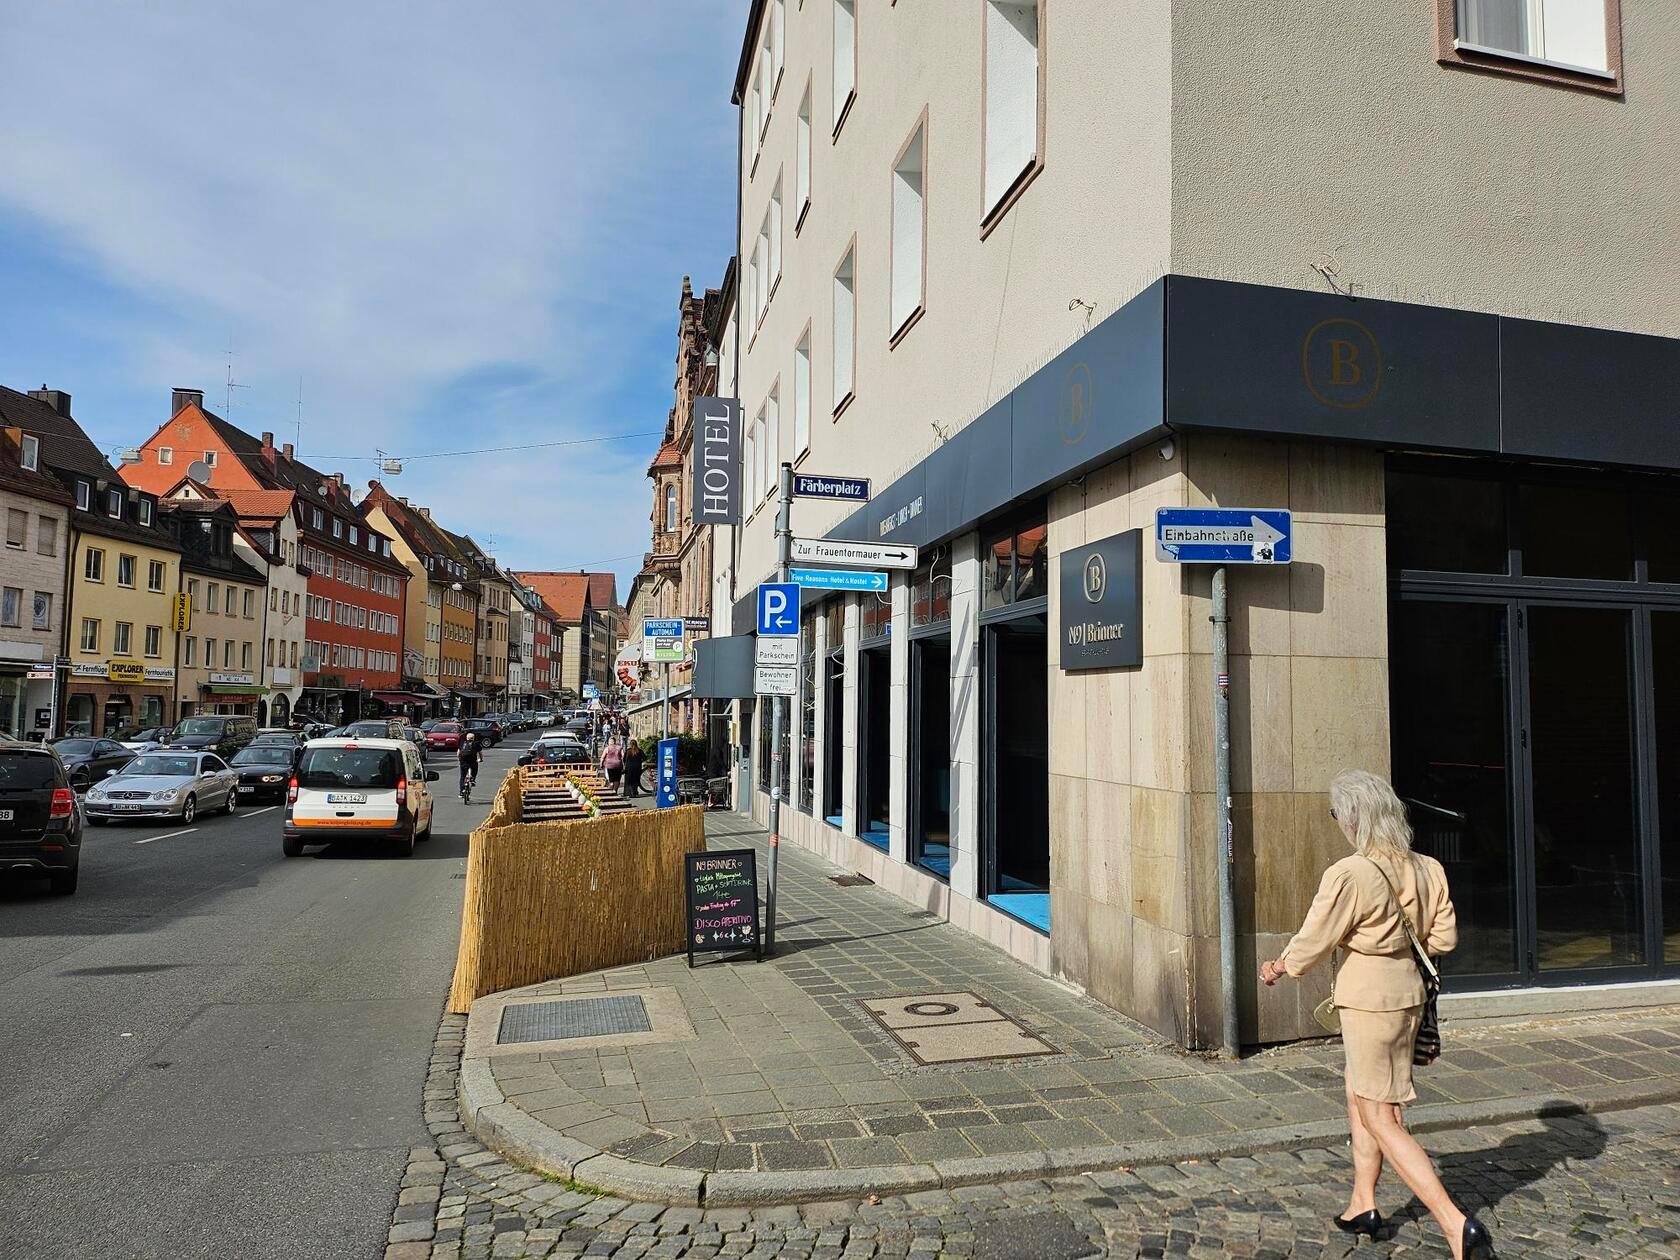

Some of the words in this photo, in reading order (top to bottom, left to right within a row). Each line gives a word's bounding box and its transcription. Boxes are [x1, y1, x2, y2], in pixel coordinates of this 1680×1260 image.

[1329, 339, 1361, 385] B
[703, 403, 730, 517] HOTEL
[800, 478, 861, 496] Färberplatz
[798, 544, 811, 555] Zur
[815, 545, 881, 559] Frauentormauer
[805, 574, 828, 583] Reasons
[831, 576, 845, 584] Hotel
[1088, 565, 1101, 592] B
[178, 592, 186, 631] EXPLORER
[764, 590, 787, 628] P
[1068, 625, 1082, 645] N9
[1087, 621, 1124, 643] Brinner
[760, 651, 795, 660] Parkschein
[82, 664, 107, 674] Fernflüge
[112, 663, 144, 674] EXPLORER
[145, 668, 173, 677] Ferntouristik
[759, 670, 792, 679] Bewohner
[707, 859, 737, 871] BRINNER
[696, 884, 714, 894] PASTA
[695, 918, 720, 929] DISCO
[721, 915, 752, 926] APERITIVO
